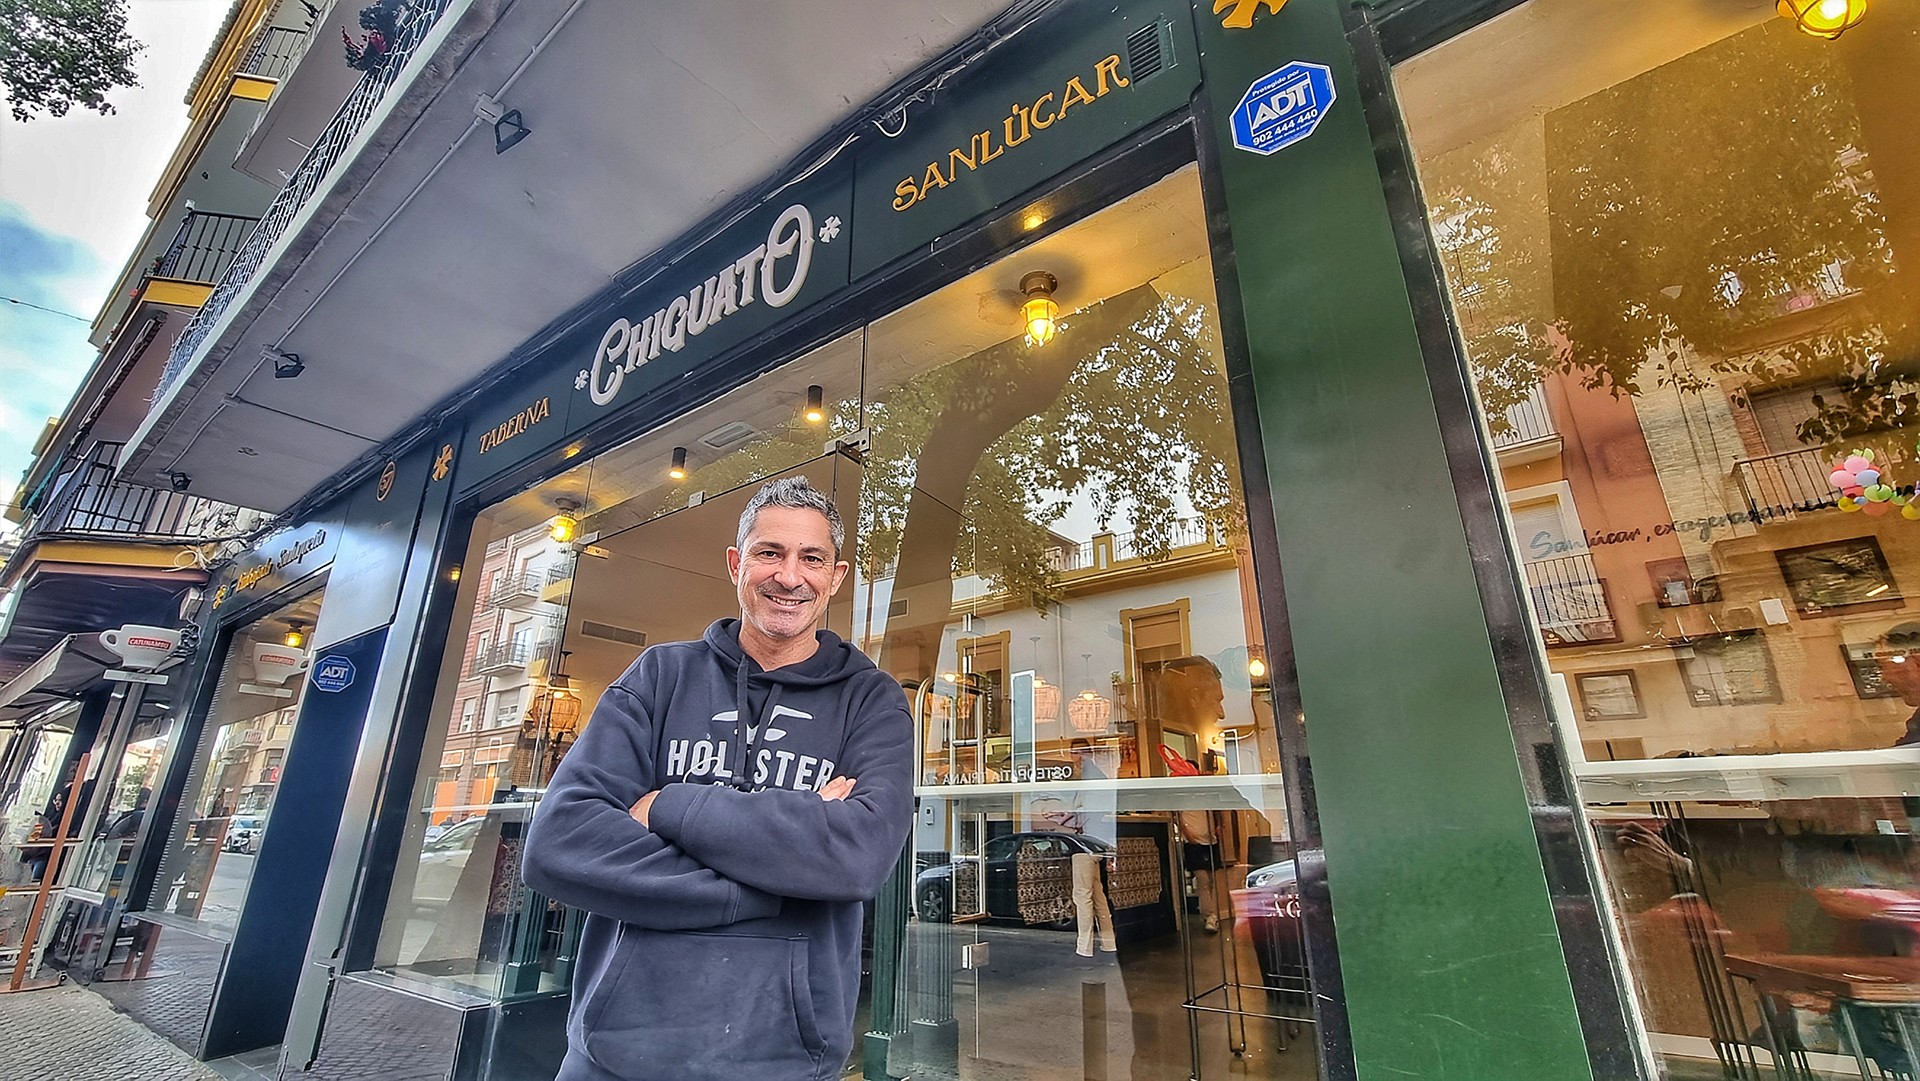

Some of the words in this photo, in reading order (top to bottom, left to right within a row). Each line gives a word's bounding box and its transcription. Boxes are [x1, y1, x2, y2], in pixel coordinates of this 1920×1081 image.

[1252, 76, 1286, 97] Protegido
[1287, 69, 1300, 80] por
[1252, 78, 1310, 129] ADT
[892, 54, 1129, 211] SANLÚCAR
[1252, 130, 1273, 146] 902
[1274, 119, 1295, 134] 444
[1297, 108, 1318, 124] 440
[589, 203, 815, 406] CHIGUATO
[479, 397, 550, 454] TABERNA
[320, 666, 349, 679] ADT
[666, 739, 836, 792] HOLSTER
